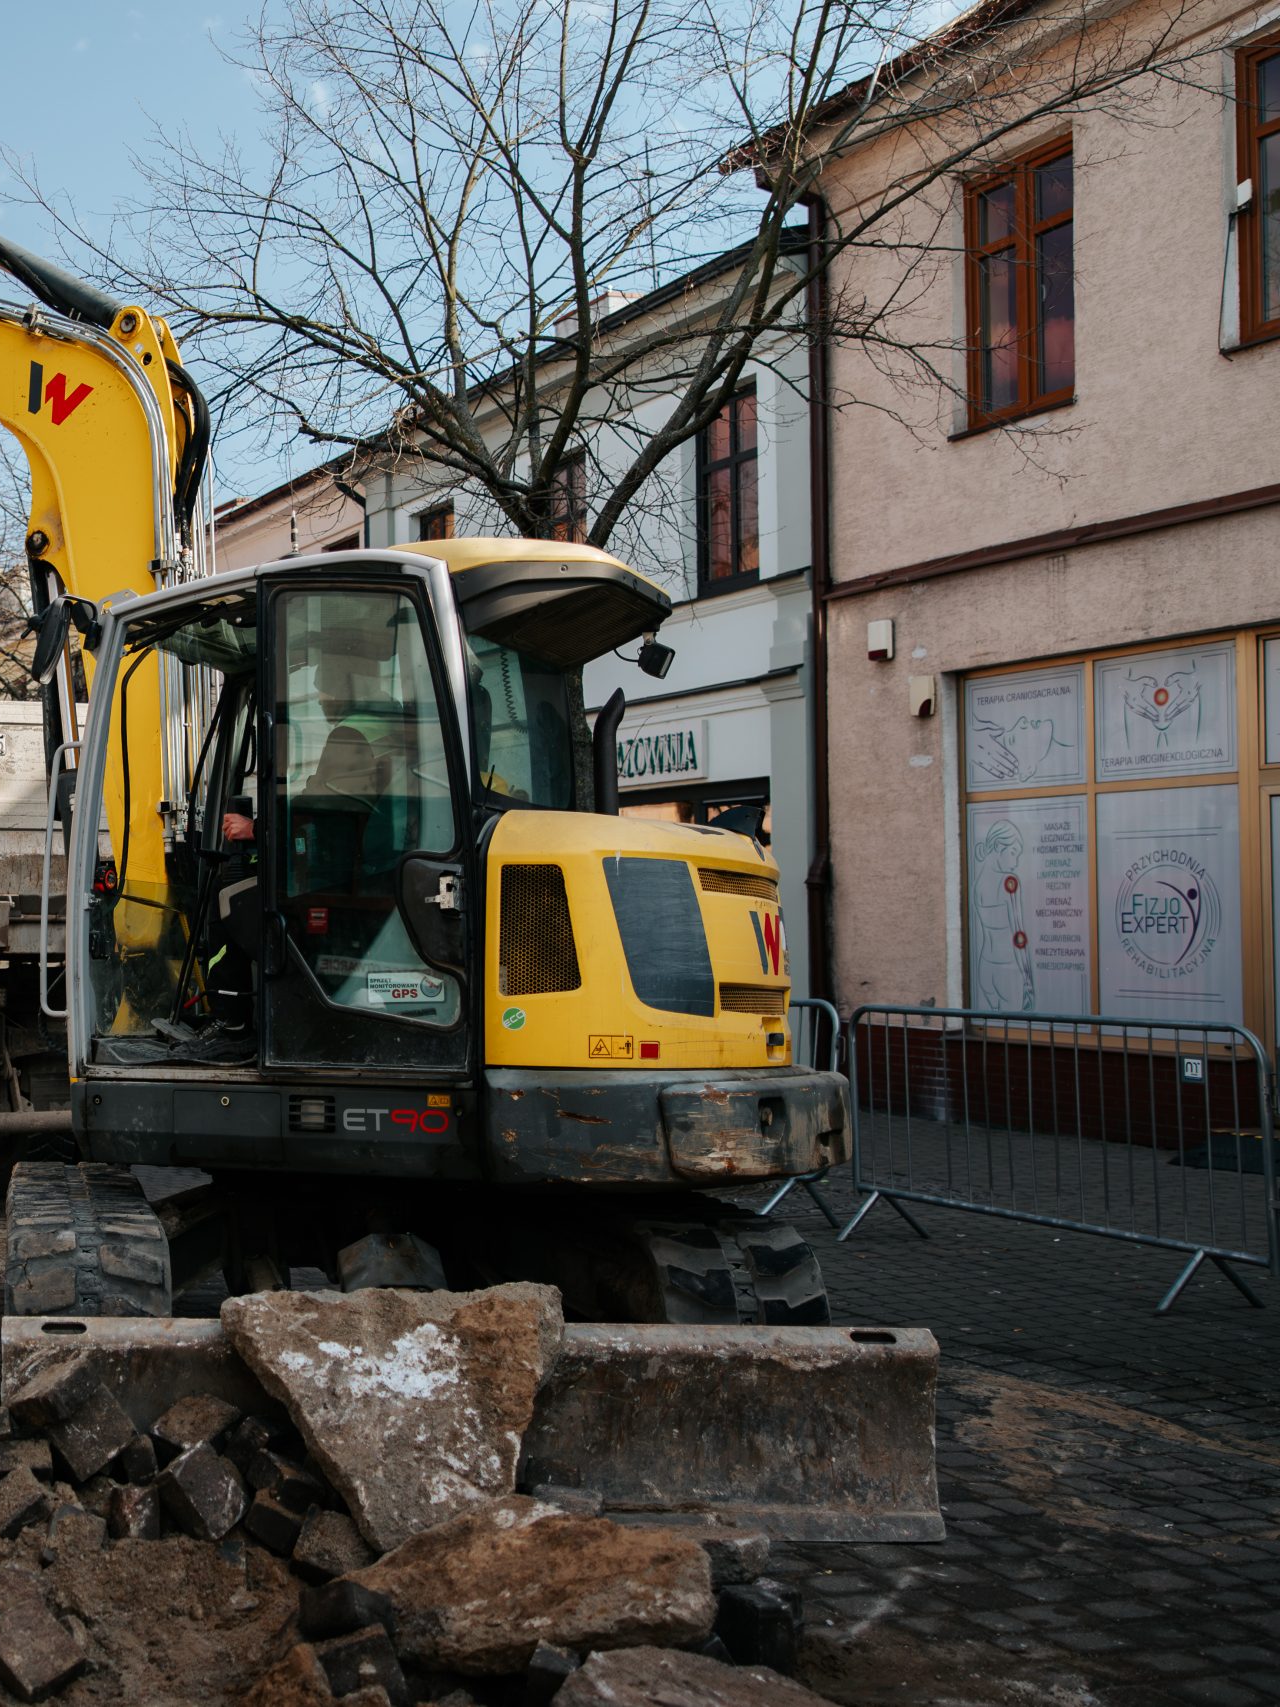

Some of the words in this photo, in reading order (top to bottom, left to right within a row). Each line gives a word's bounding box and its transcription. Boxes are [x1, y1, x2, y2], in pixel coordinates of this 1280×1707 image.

[976, 696, 1005, 706] TERAPIA
[1006, 686, 1072, 702] CRANIOSACRALNA
[1100, 757, 1132, 768] TERAPIA
[1134, 748, 1224, 766] UROGINEKOLOGICZNA
[1040, 833, 1076, 843] LECZNICZE
[1036, 844, 1084, 854] KOSMETYCZNE
[1125, 849, 1207, 882] PRZYCHODNIA
[1036, 909, 1083, 918] MECHANICZNY
[1035, 948, 1086, 957] KINEZYTERAPIA
[1120, 938, 1216, 980] REHABILITACYJNA
[392, 989, 418, 998] GPS
[503, 1010, 526, 1027] ECO
[342, 1108, 449, 1134] ET90
